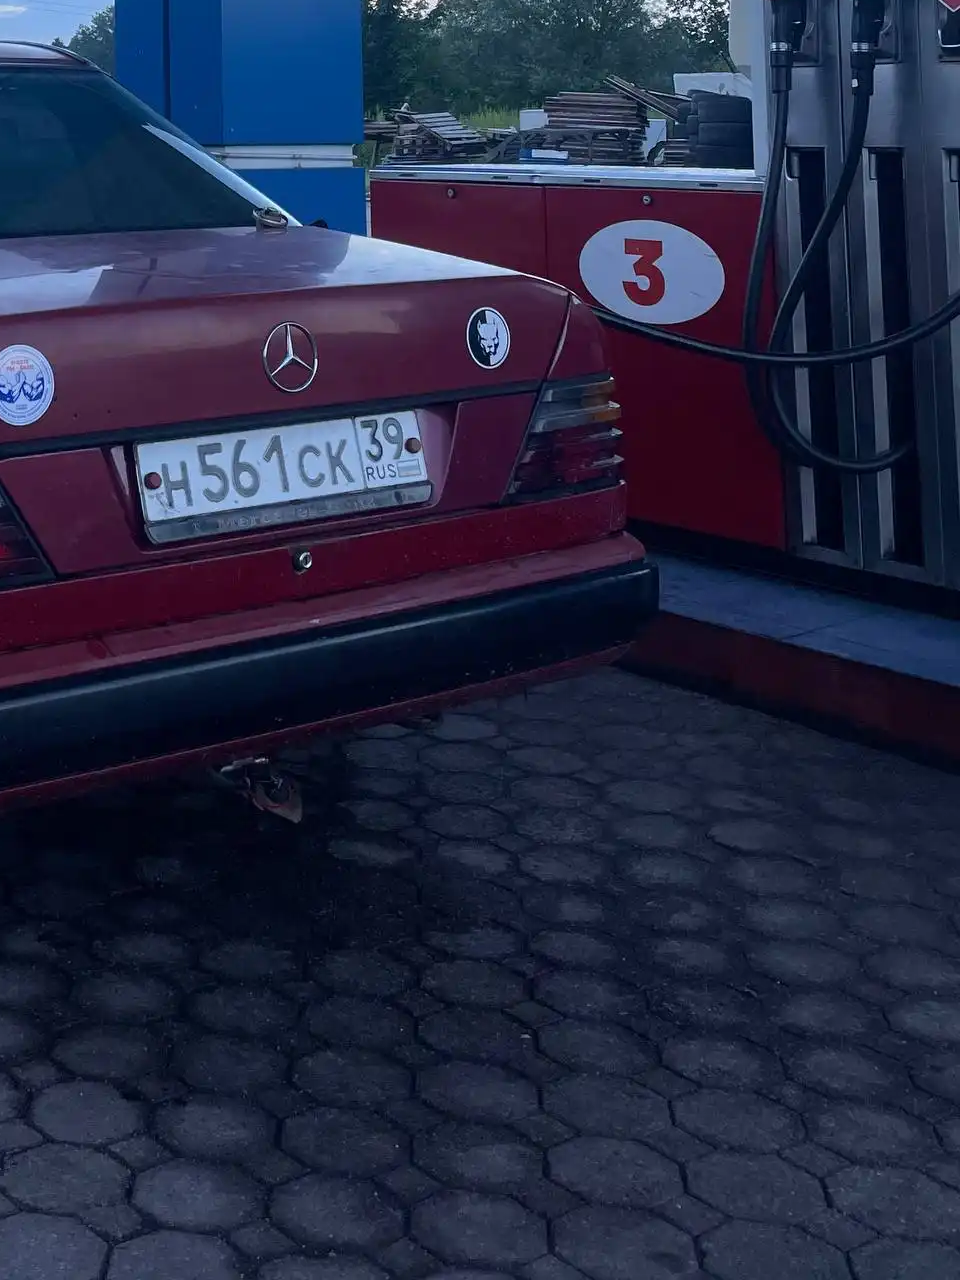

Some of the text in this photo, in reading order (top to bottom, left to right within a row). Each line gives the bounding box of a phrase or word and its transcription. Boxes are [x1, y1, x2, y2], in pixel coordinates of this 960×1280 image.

[622, 238, 666, 307] 3
[161, 417, 404, 508] Н561СК 39
[365, 463, 397, 482] RUS
